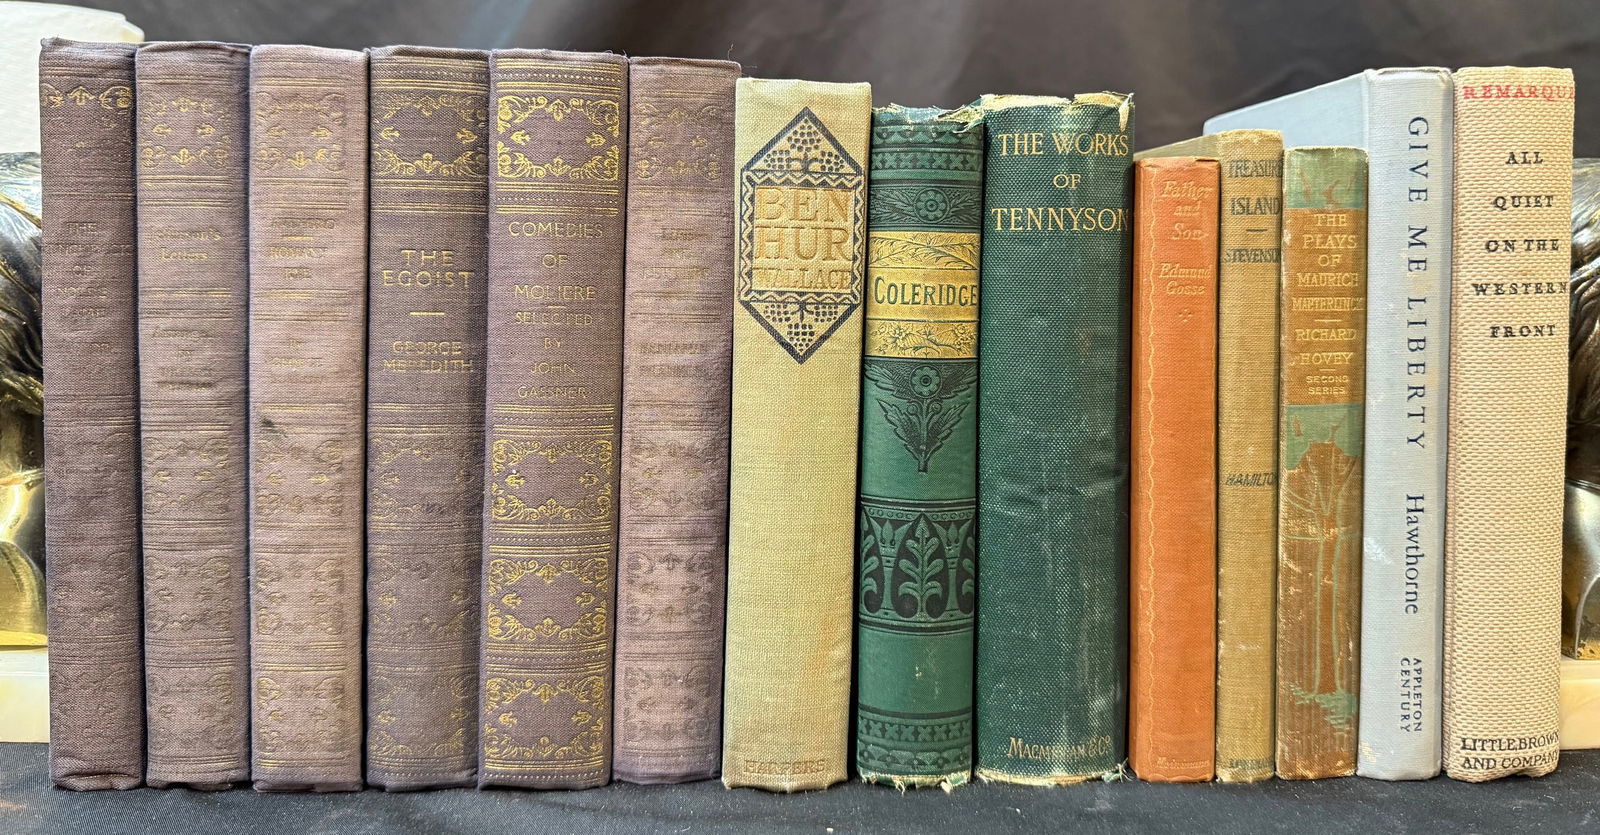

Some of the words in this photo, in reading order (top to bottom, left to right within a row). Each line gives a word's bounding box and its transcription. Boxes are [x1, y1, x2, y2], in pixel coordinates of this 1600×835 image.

[998, 132, 1044, 156] THE
[1051, 132, 1129, 156] WORKS
[1408, 115, 1429, 203] GIVE
[1506, 151, 1544, 165] ALL
[1053, 173, 1082, 190] OF
[1160, 180, 1213, 200] Father
[755, 187, 852, 222] BEN
[1173, 201, 1200, 216] and
[1231, 197, 1281, 215] ISLAND
[1493, 195, 1554, 211] QUIET
[991, 207, 1129, 232] TENNYSON
[1313, 213, 1348, 227] THE
[508, 221, 603, 239] COMEDIES
[1169, 222, 1209, 240] Son
[754, 225, 854, 262] HUR
[1302, 234, 1358, 250] PLAYS
[1407, 225, 1428, 273] ME
[1485, 239, 1518, 253] ON
[1524, 239, 1560, 251] THE
[401, 249, 454, 267] THE
[542, 254, 568, 268] OF
[1317, 254, 1342, 267] OF
[382, 269, 475, 288] EGOIST
[753, 267, 852, 290] WALLACE
[1158, 262, 1212, 279] Edmund
[1296, 272, 1359, 287] MAURICE
[514, 285, 596, 300] MOLIERE
[874, 275, 978, 307] COLERIDGE
[1165, 281, 1207, 295] Gosse
[1471, 281, 1567, 296] WESTERN
[515, 311, 593, 325] SELECTED
[1295, 328, 1357, 341] RICHARD
[1490, 325, 1556, 338] FRONT
[392, 341, 462, 355] GEORGE
[544, 337, 562, 349] BY
[382, 359, 473, 374] MEREDITH
[1299, 351, 1354, 366] HOVEY
[530, 363, 575, 375] JOHN
[1406, 297, 1427, 449] LIBERTY
[1306, 375, 1349, 384] SECOND
[517, 385, 587, 399] GASSNER
[1308, 387, 1346, 395] SERIES
[1405, 494, 1425, 615] Hawthorne
[1400, 657, 1411, 733] CENTURY
[1413, 658, 1423, 732] APPLETON
[743, 759, 825, 775] HARPERS
[1462, 757, 1497, 769] AND
